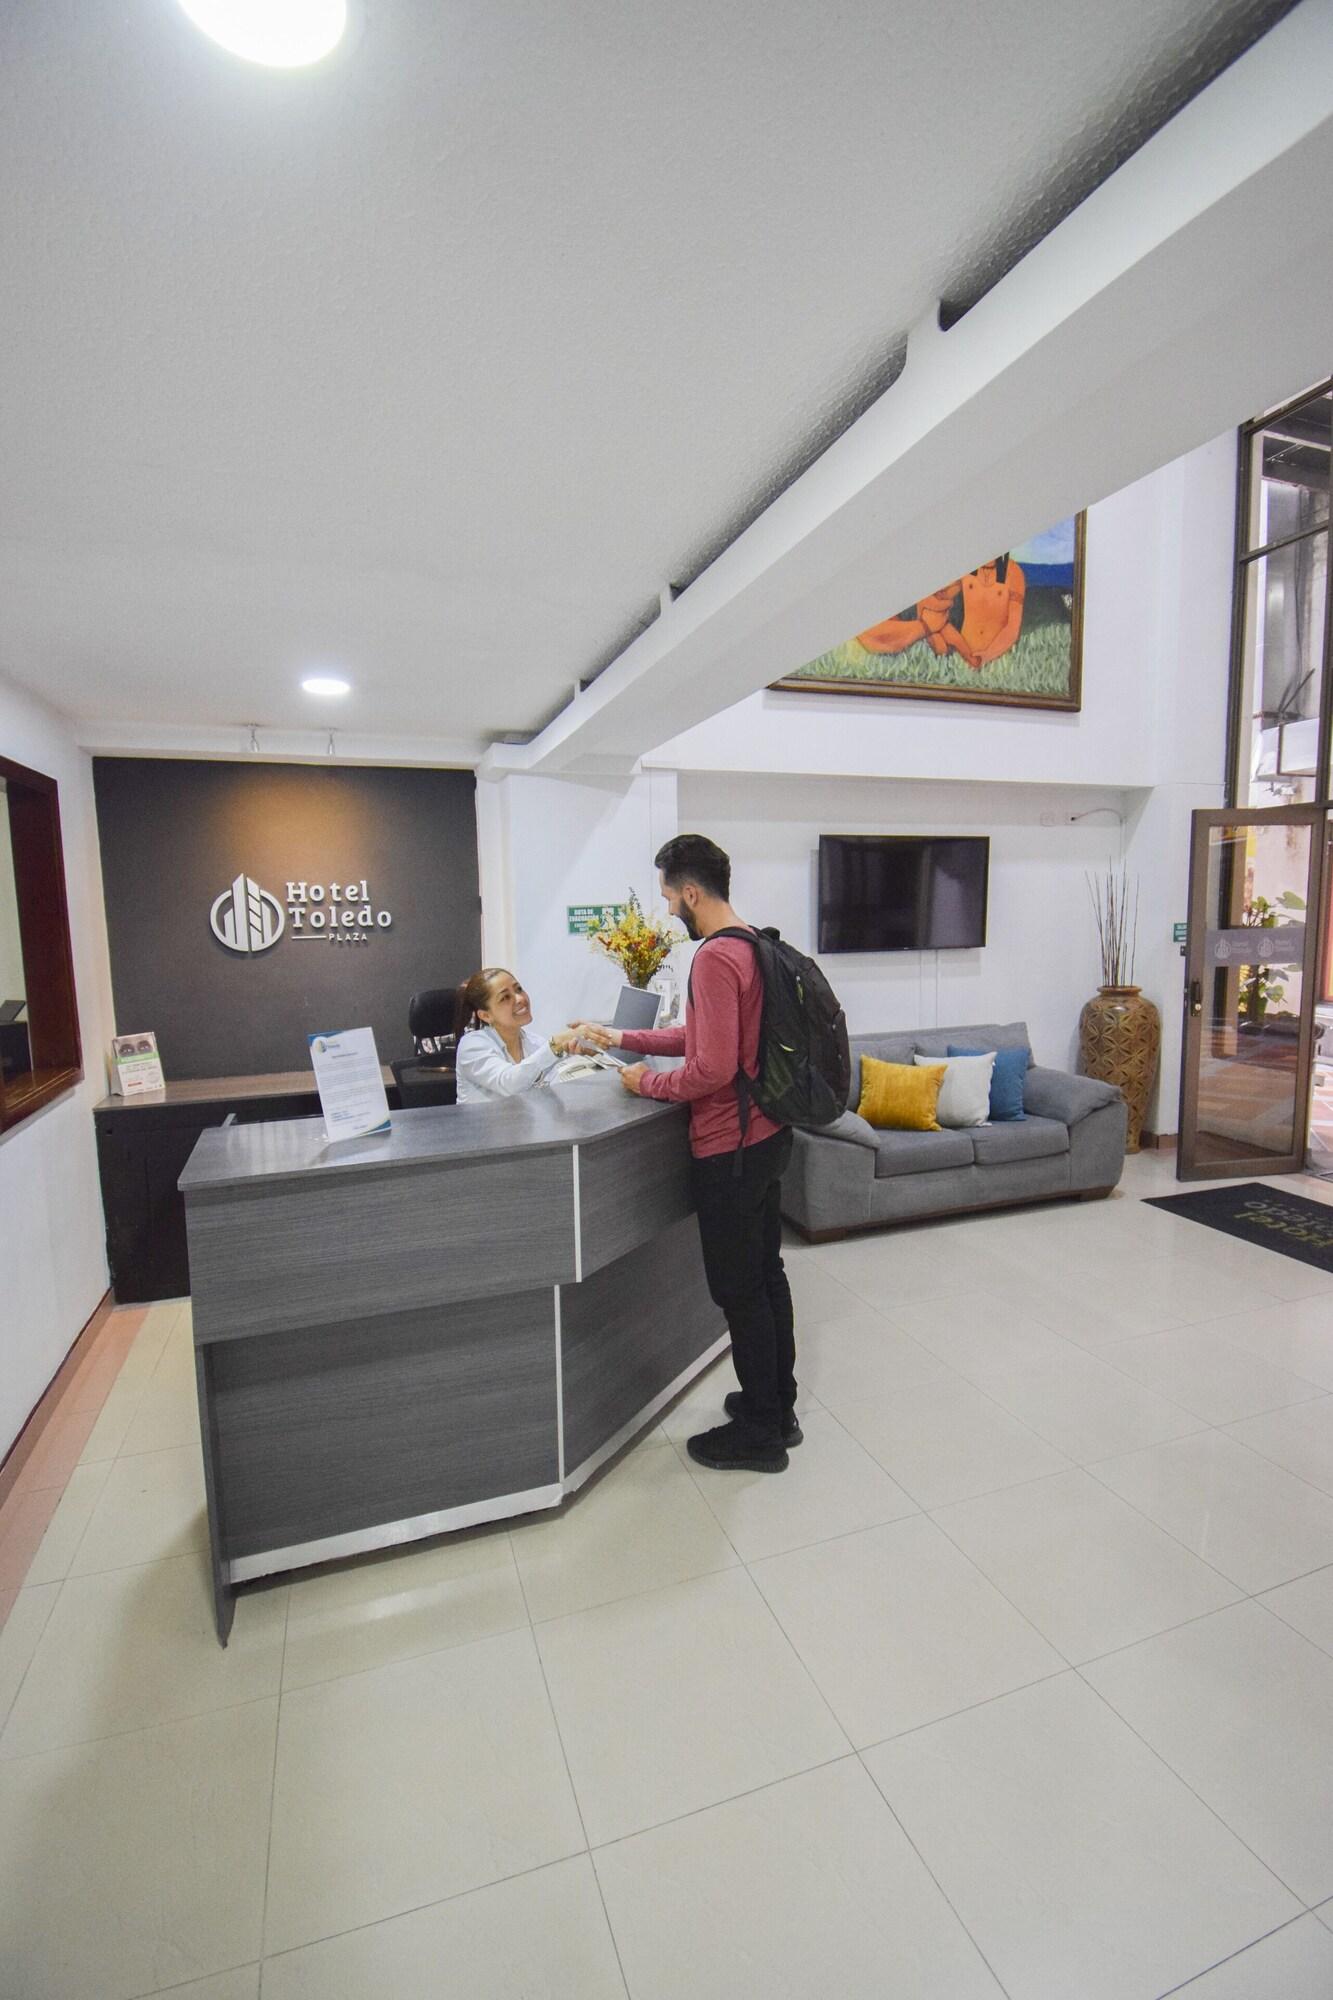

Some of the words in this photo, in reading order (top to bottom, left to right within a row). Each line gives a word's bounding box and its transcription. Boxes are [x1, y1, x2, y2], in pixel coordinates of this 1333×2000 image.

[286, 880, 370, 902] Hotel
[288, 905, 393, 927] Toledo
[328, 932, 368, 941] PLAZA
